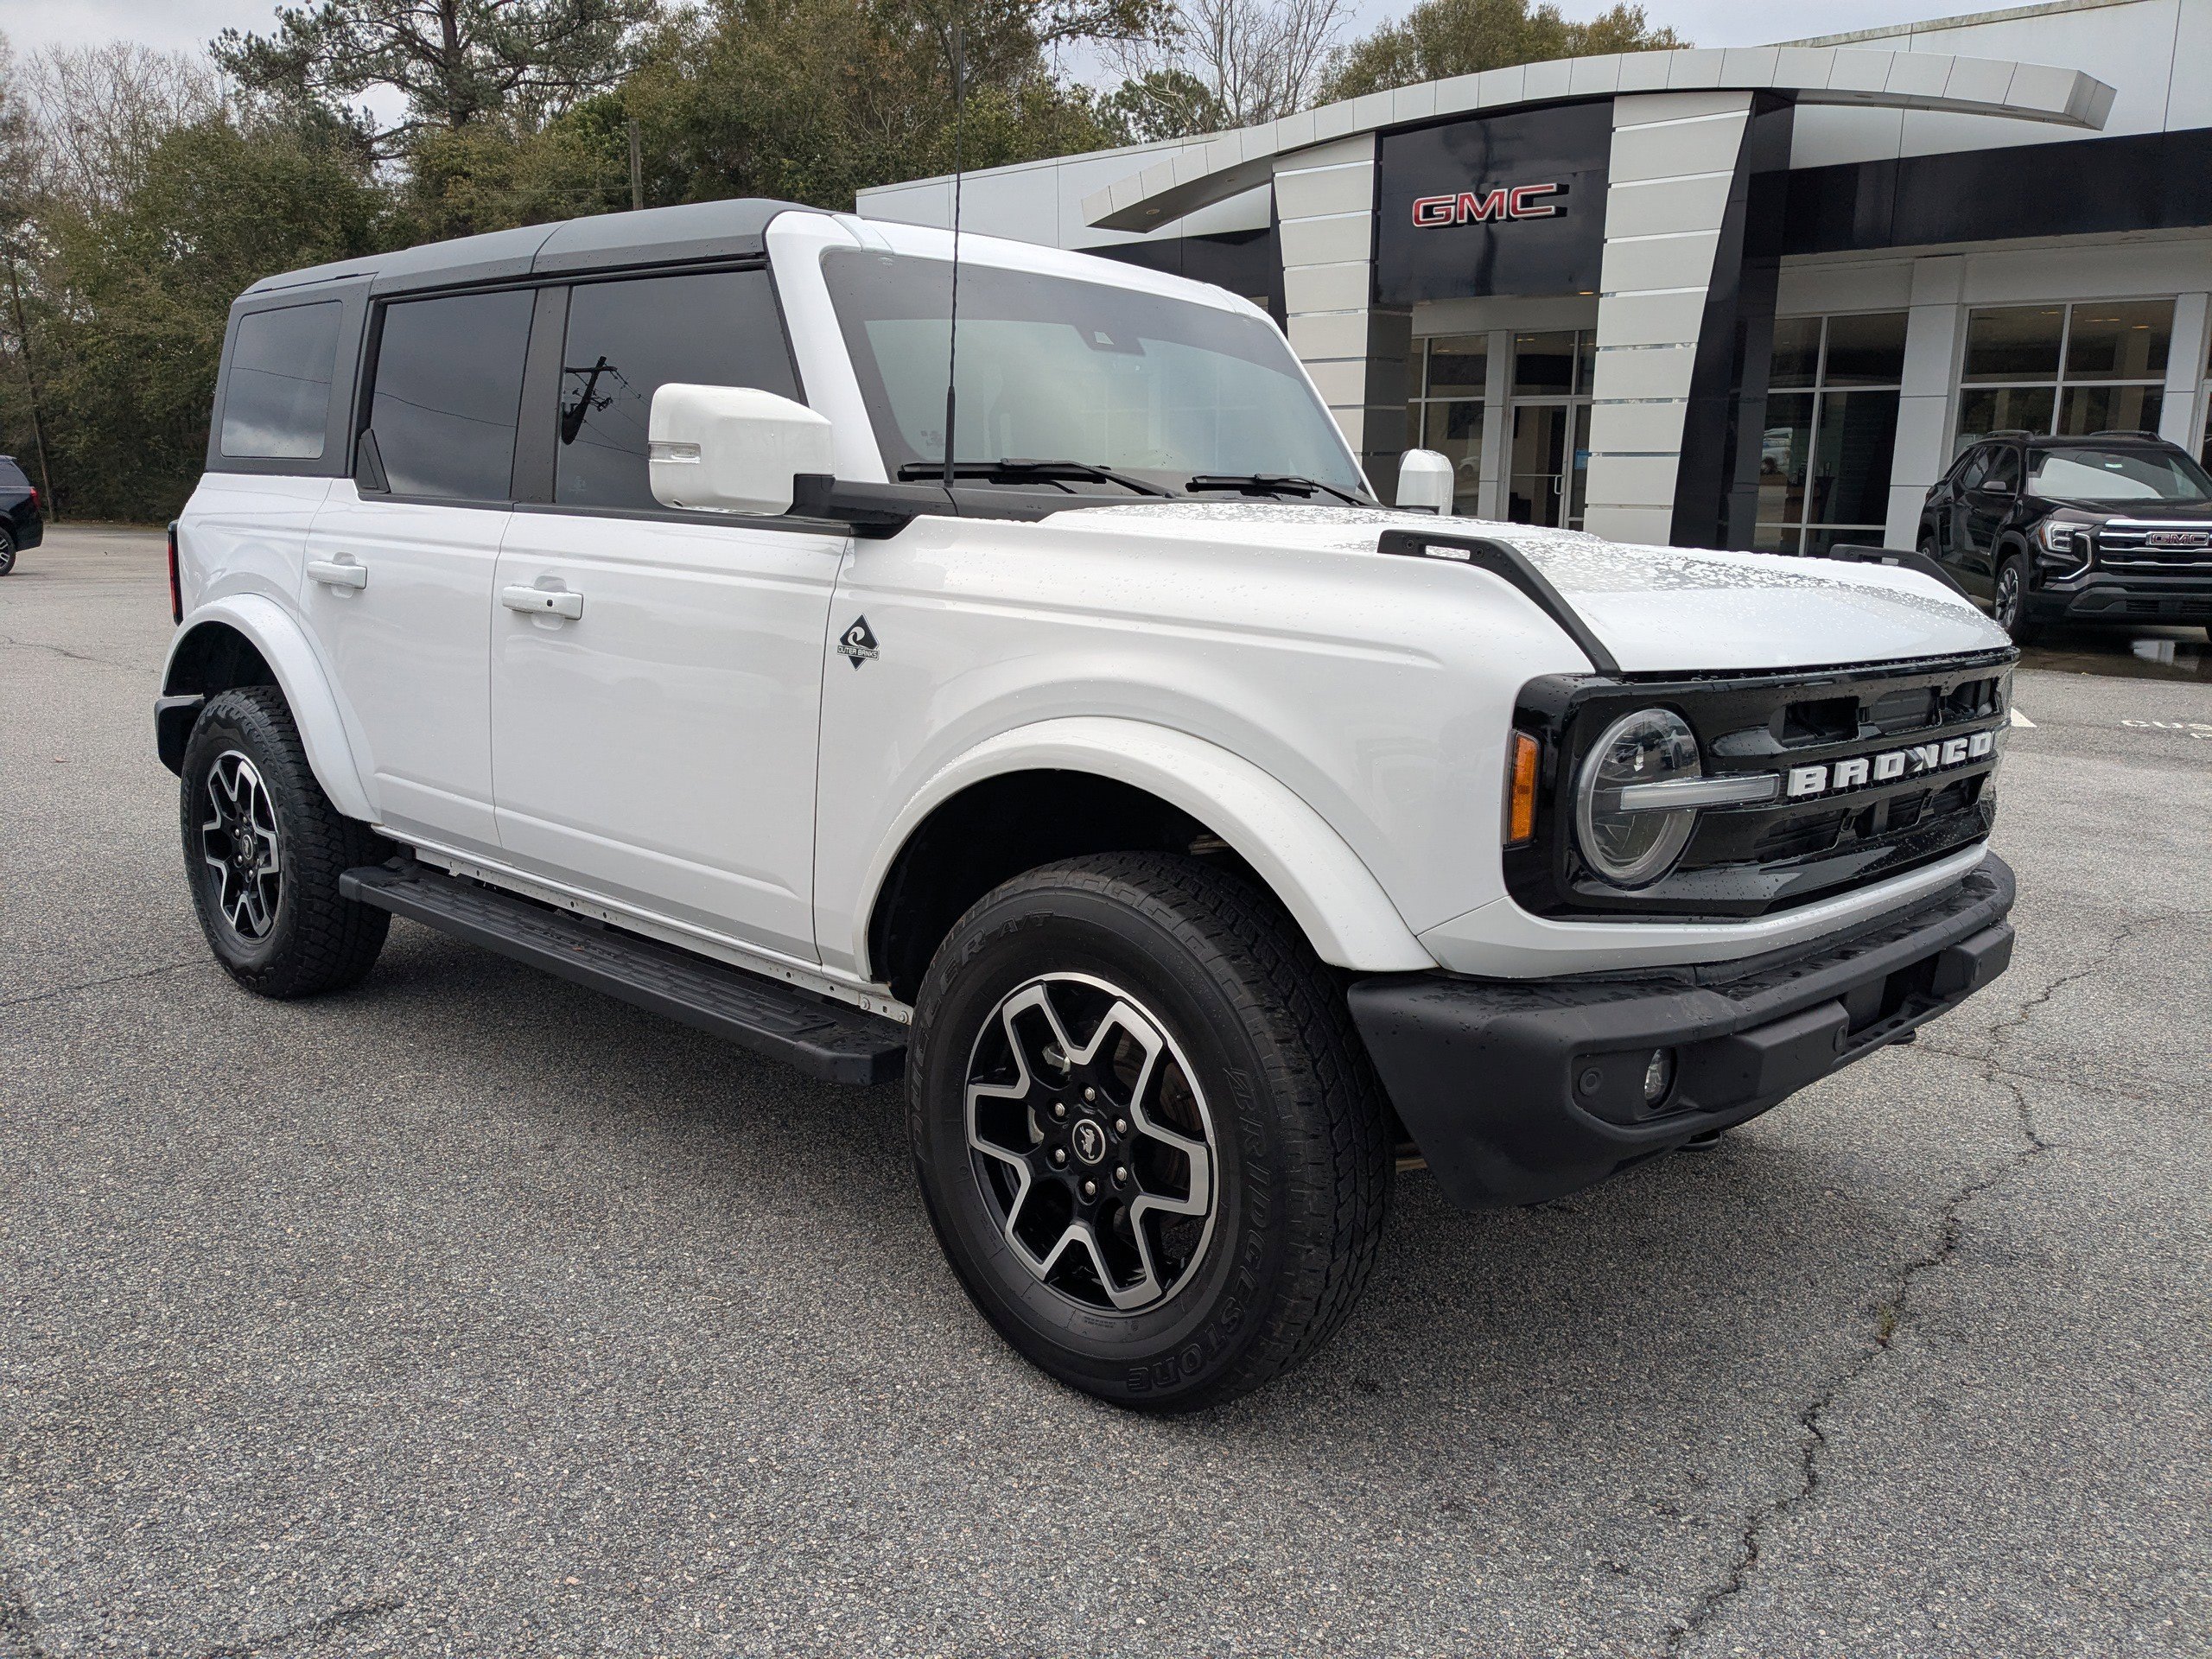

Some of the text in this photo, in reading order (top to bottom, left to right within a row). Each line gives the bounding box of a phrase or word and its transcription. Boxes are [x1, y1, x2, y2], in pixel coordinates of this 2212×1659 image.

[1412, 182, 1557, 228] GMC
[2152, 533, 2207, 543] GMC
[837, 645, 878, 658] OUTER BANKS
[1787, 732, 1992, 796] BRONCO
[1126, 1066, 1273, 1393] BRIDGESTONE
